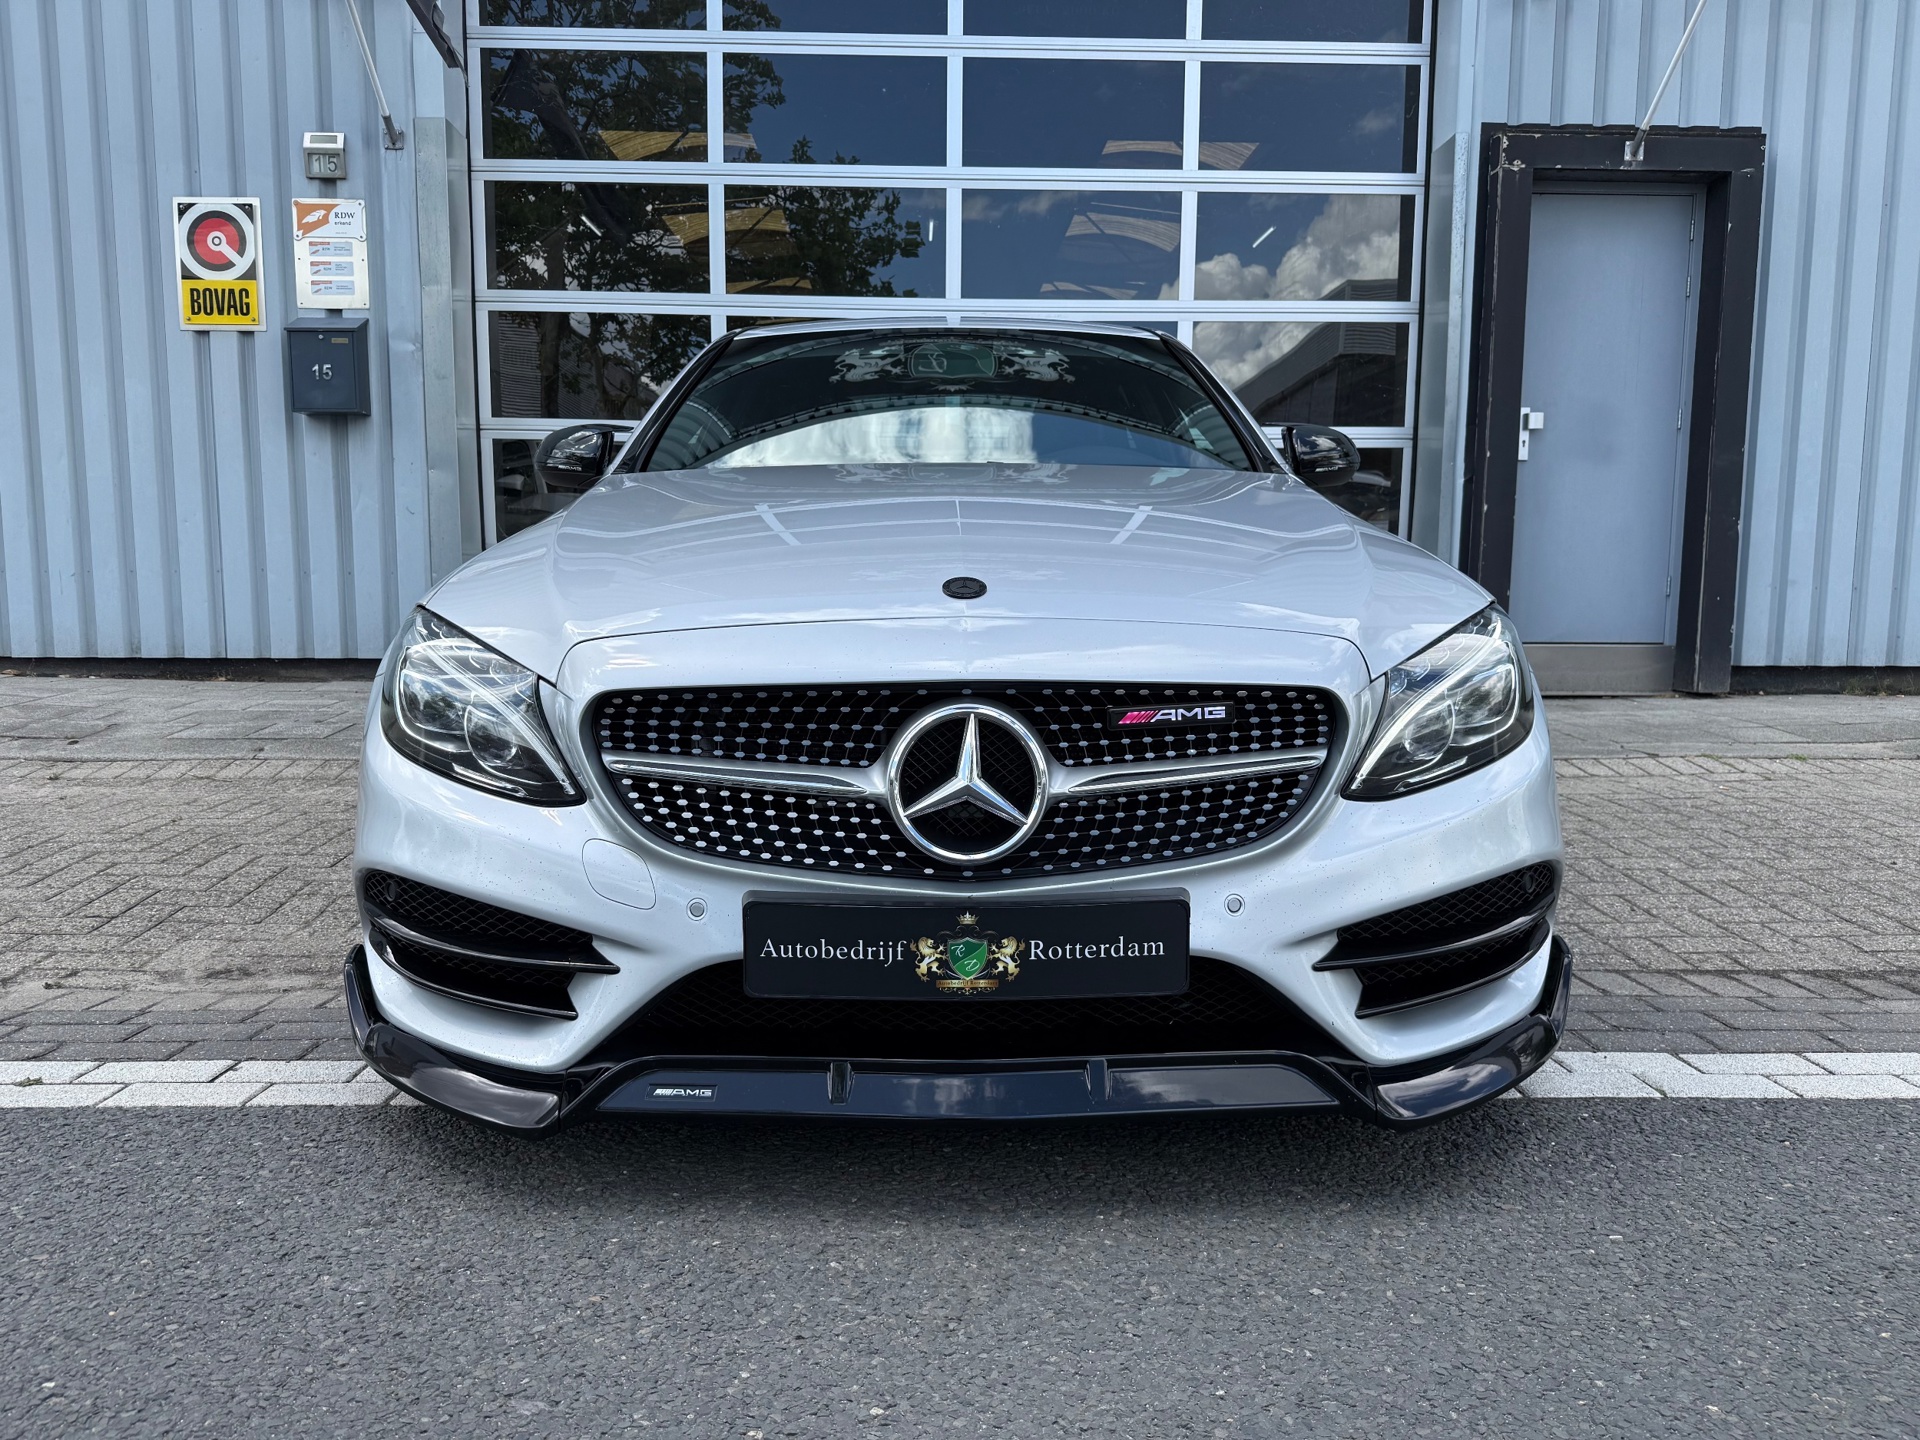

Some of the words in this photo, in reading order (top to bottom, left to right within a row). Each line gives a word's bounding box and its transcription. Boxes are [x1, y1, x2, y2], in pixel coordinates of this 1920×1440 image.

[314, 155, 338, 173] 15
[334, 211, 355, 219] RDW
[189, 287, 251, 317] BOVAG
[312, 363, 333, 380] 15
[1150, 706, 1226, 723] AMG
[760, 938, 908, 968] Autobedrijf
[1028, 935, 1166, 961] Rotterdam
[670, 1088, 713, 1097] AMG
